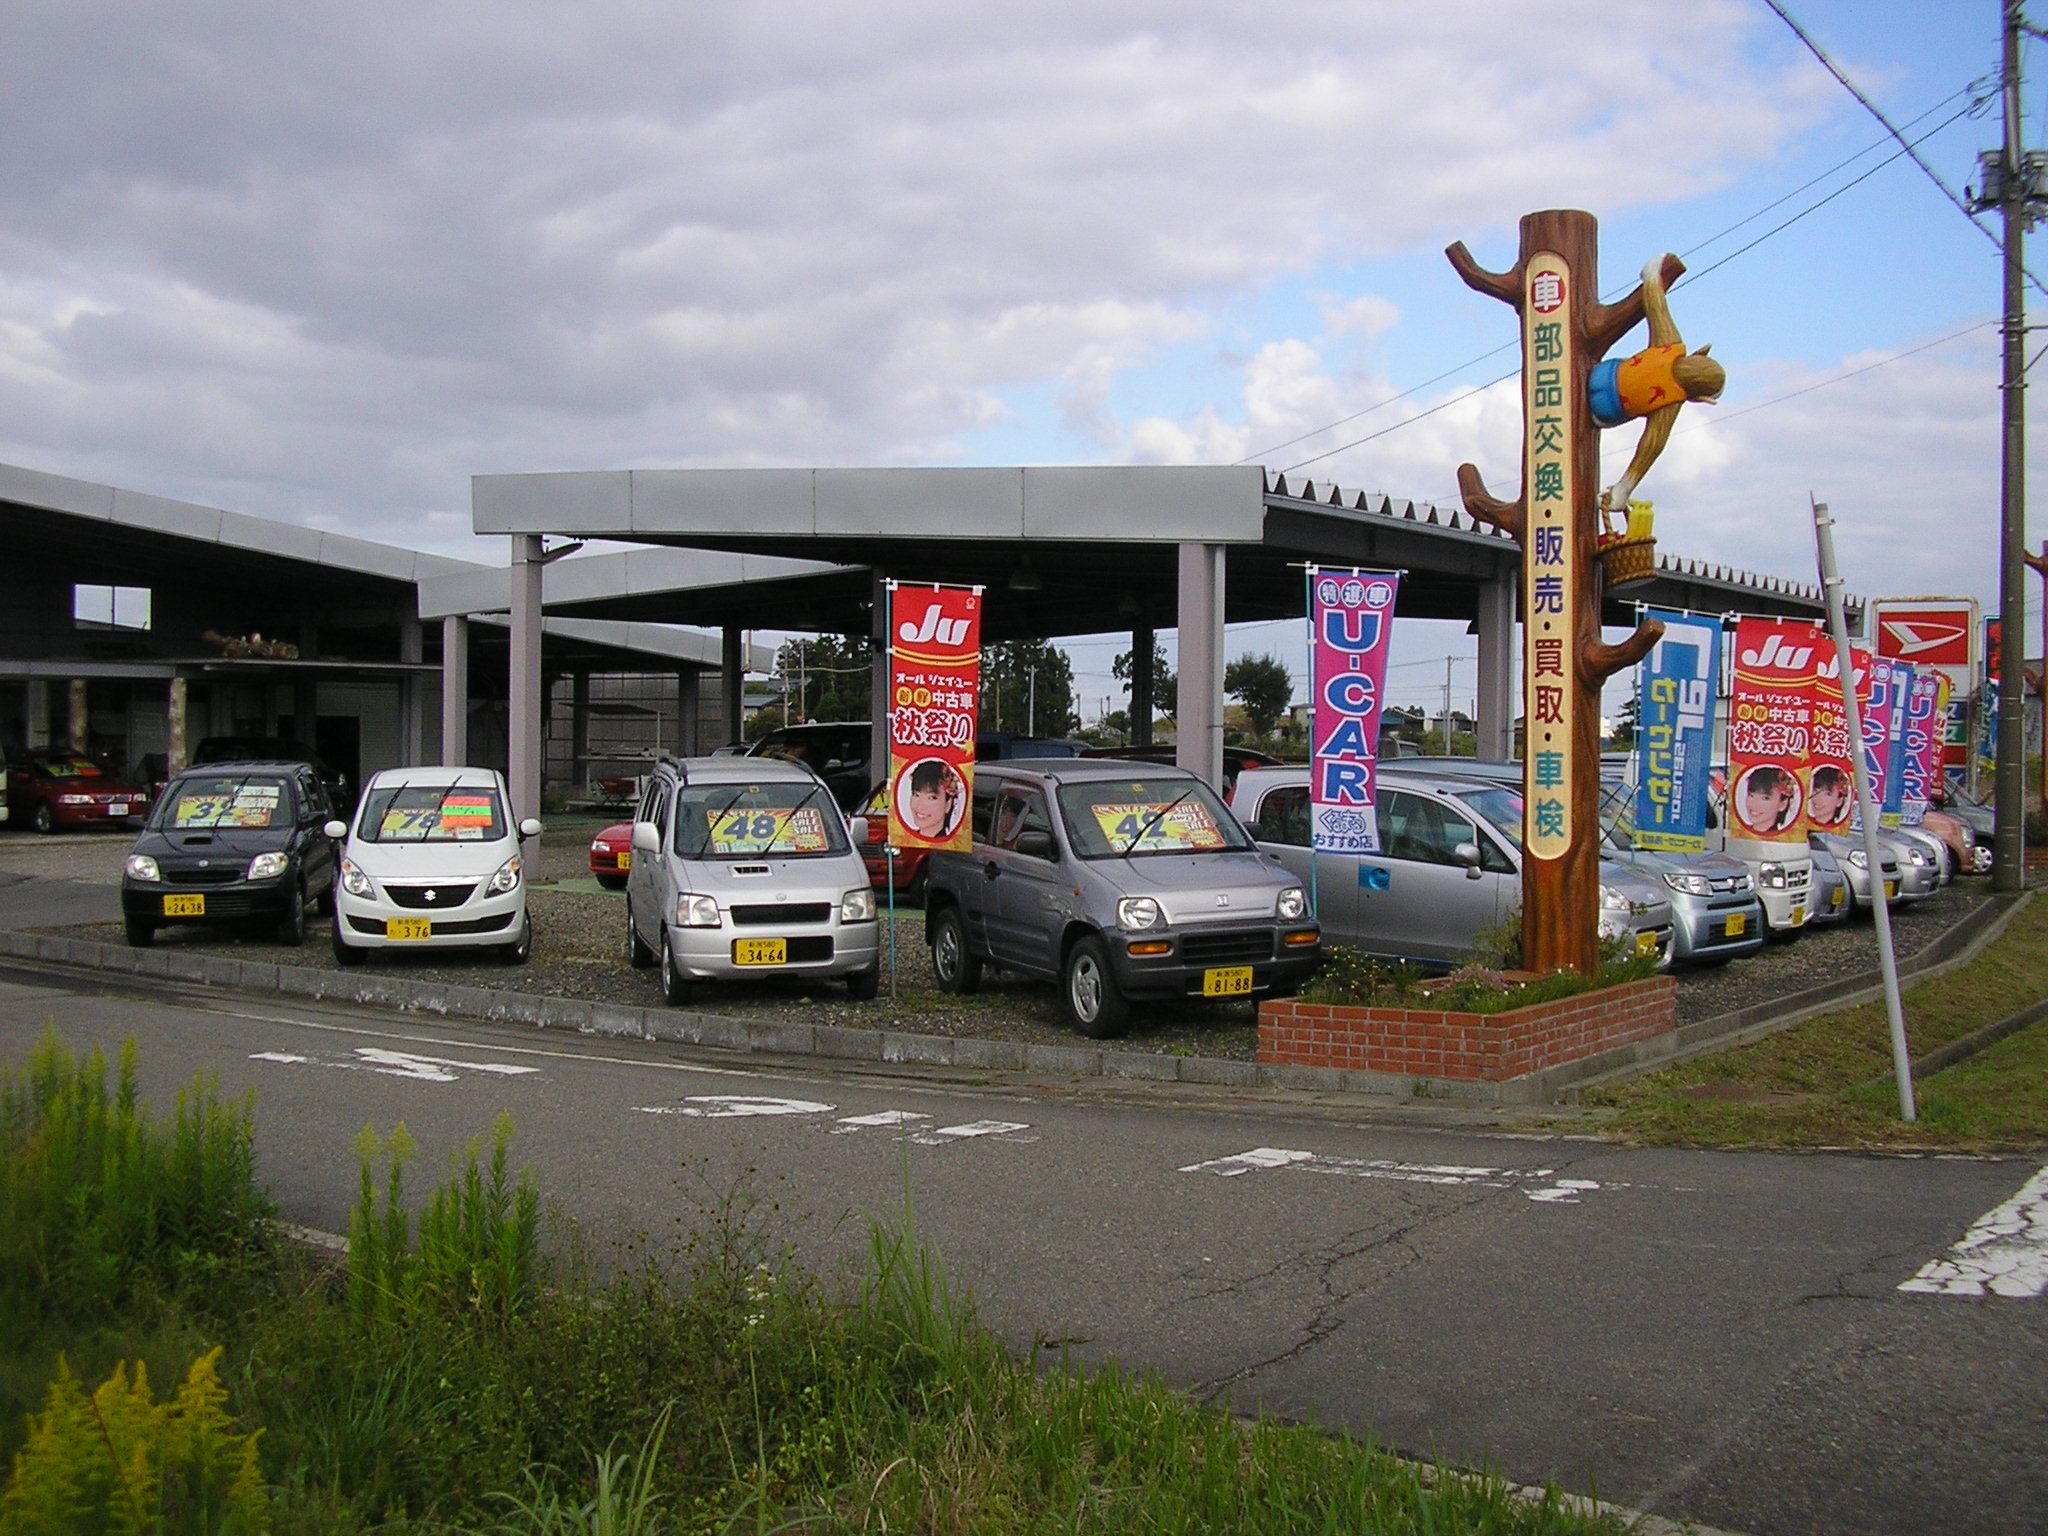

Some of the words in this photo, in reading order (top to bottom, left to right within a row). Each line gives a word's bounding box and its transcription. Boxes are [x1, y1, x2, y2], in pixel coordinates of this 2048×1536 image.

[1533, 272, 1561, 311] 車
[896, 673, 925, 685] オール
[893, 708, 973, 747] 秋祭り
[1733, 720, 1809, 756] 秋祭り
[723, 814, 776, 840] 48
[1314, 833, 1373, 849] おすすめ店
[747, 949, 783, 962] 34-64
[1214, 977, 1250, 992] 81-88
